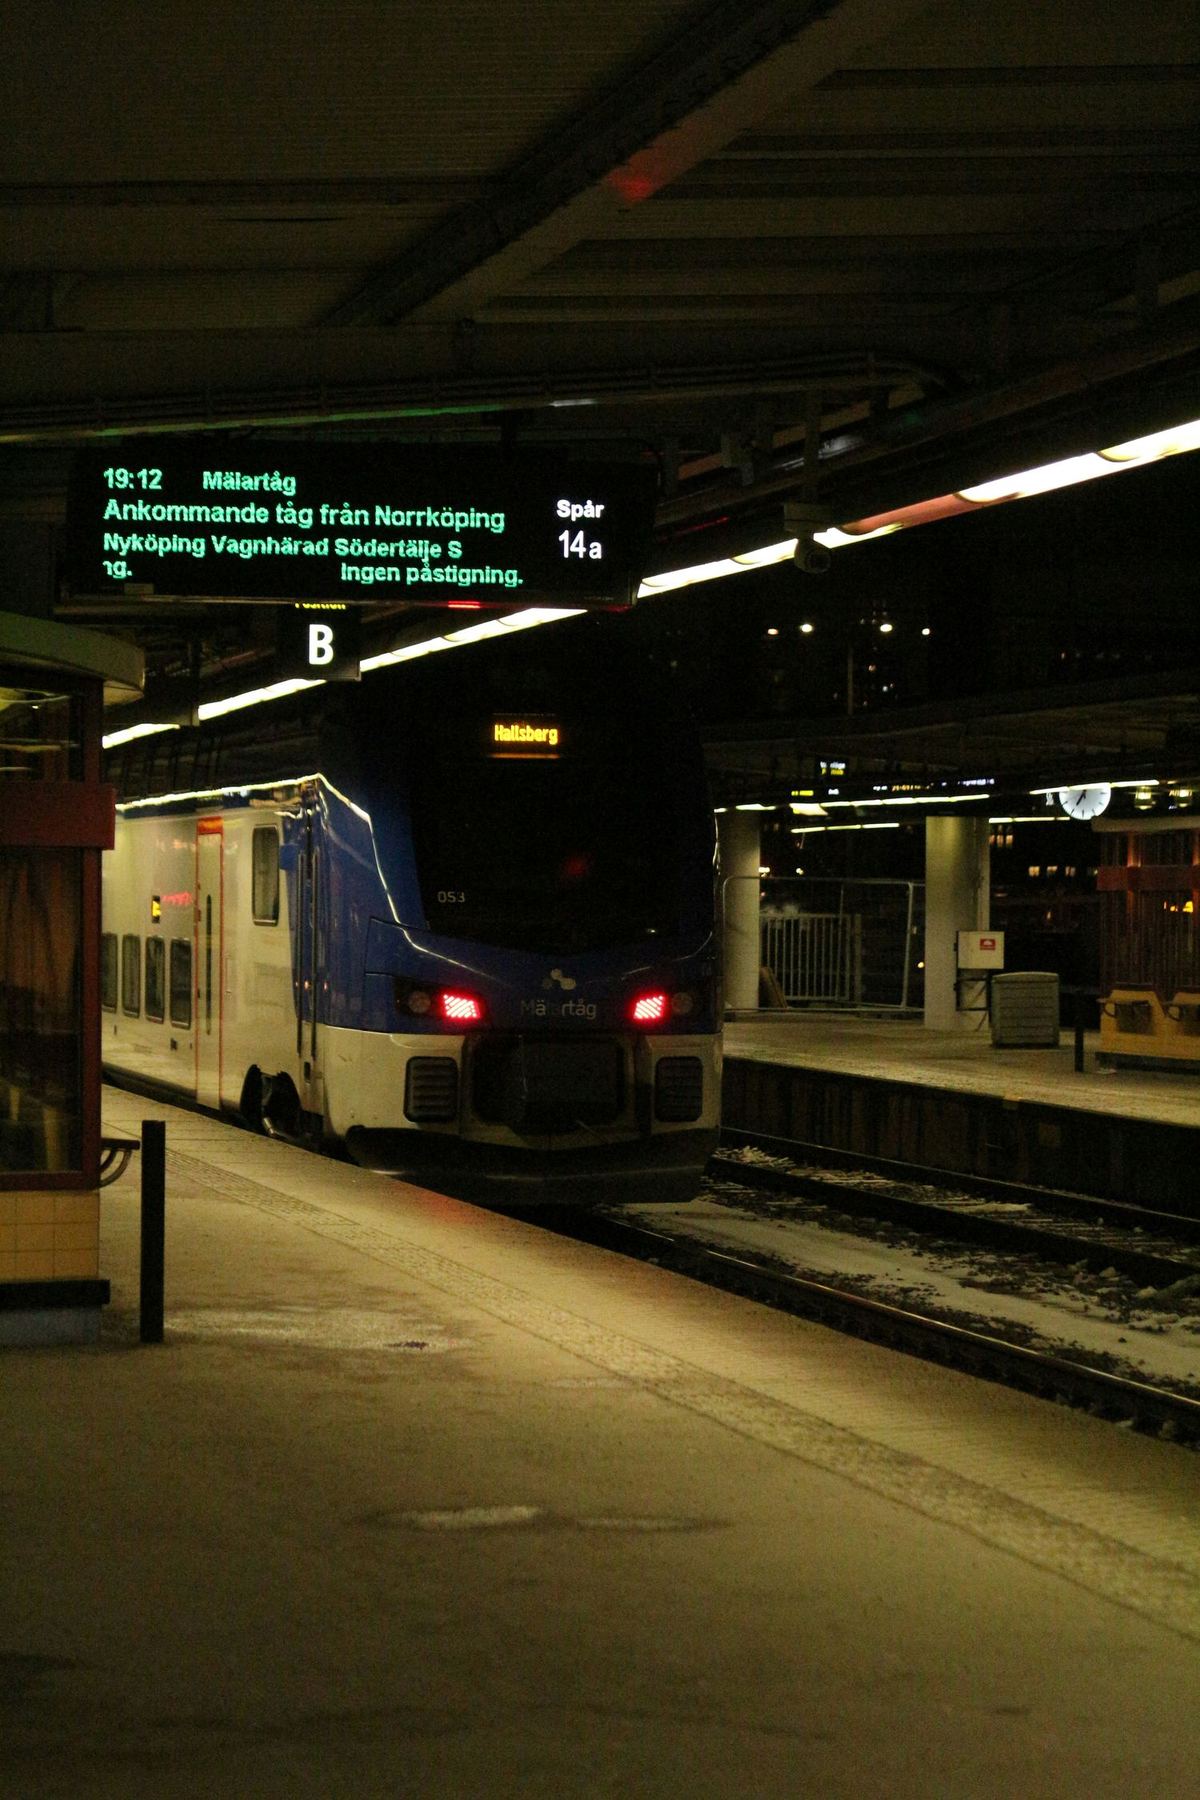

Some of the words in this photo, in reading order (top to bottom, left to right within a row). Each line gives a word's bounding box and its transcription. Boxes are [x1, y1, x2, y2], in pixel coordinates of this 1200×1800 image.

[103, 467, 163, 490] 19:12
[202, 470, 297, 496] Mälartåg
[103, 498, 270, 524] Ankommande
[276, 501, 314, 529] tåg
[319, 502, 370, 526] från
[374, 505, 505, 534] Norrköping
[556, 499, 605, 522] Spår
[103, 532, 206, 559] Nyköping
[211, 535, 330, 560] Vagnhärad
[334, 537, 442, 563] Södertälje
[447, 540, 463, 559] S
[340, 562, 401, 586] Ingen
[406, 562, 524, 588] påstigning.
[308, 623, 334, 666] B
[493, 724, 558, 745] Hallsberg
[520, 998, 597, 1020] Märtåg
